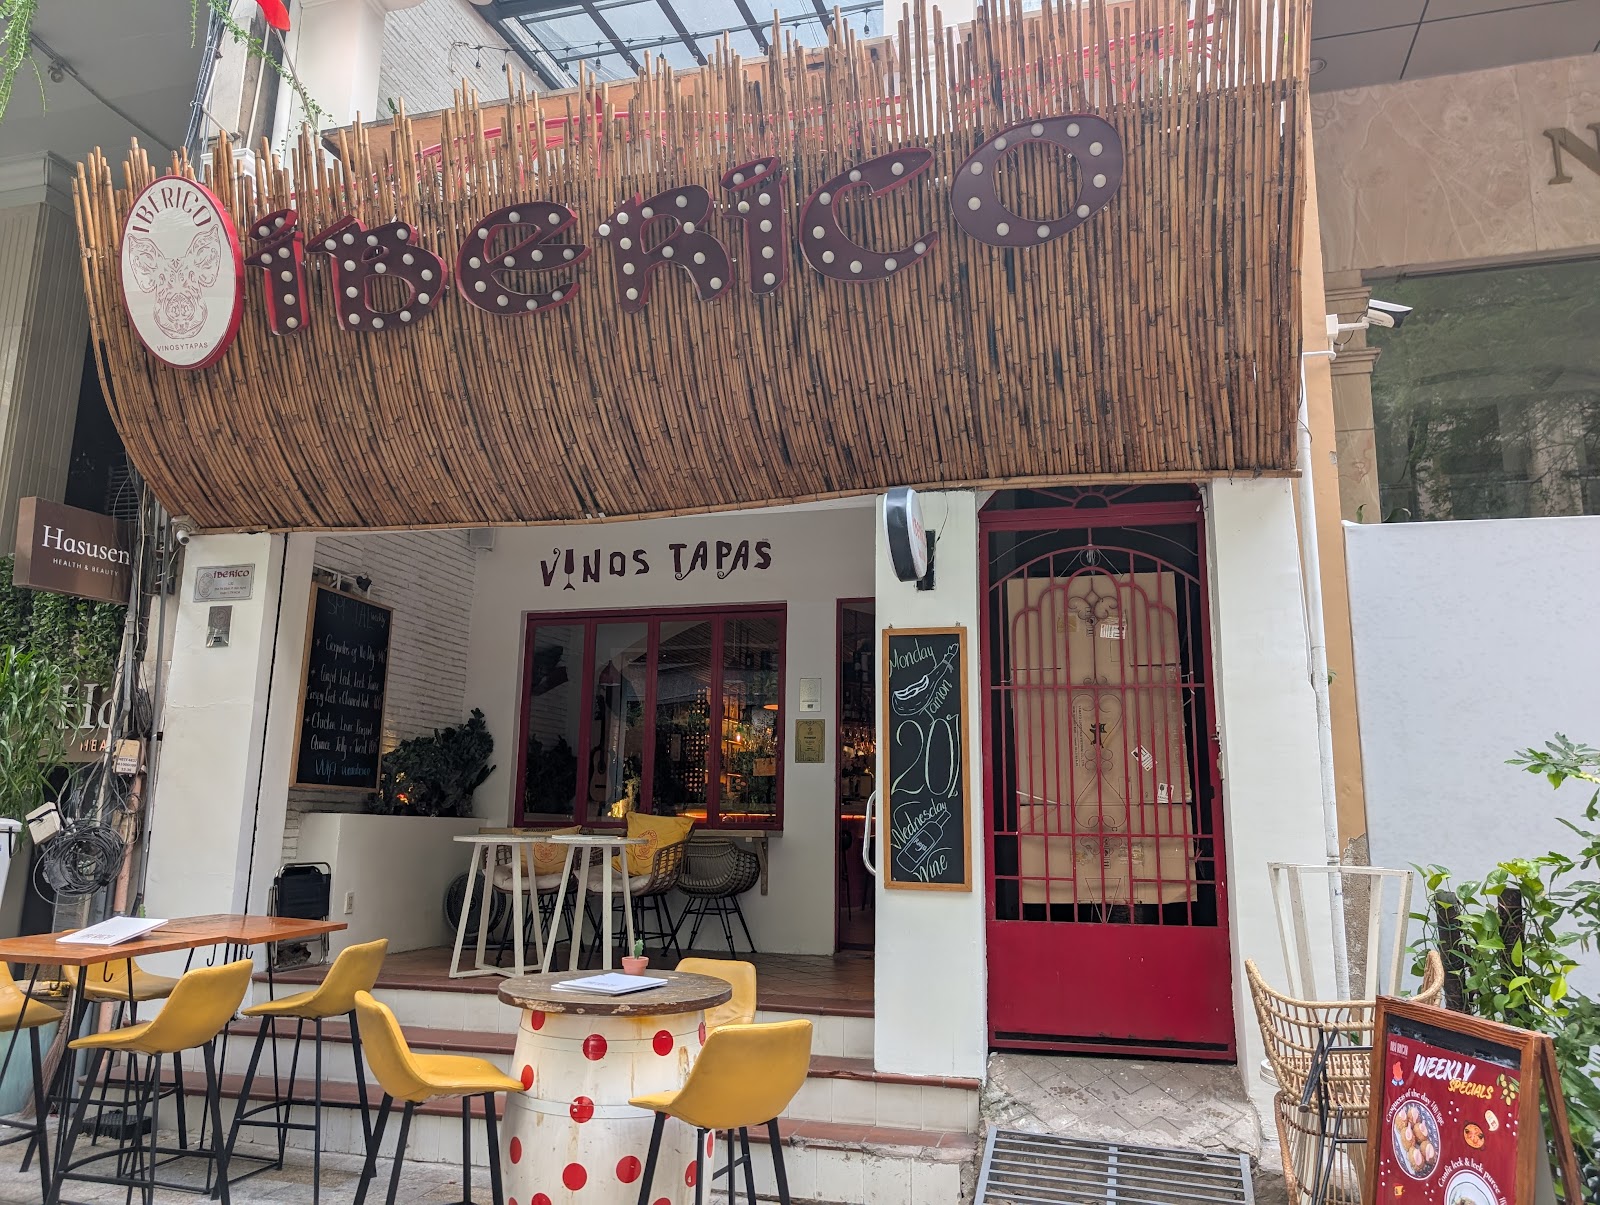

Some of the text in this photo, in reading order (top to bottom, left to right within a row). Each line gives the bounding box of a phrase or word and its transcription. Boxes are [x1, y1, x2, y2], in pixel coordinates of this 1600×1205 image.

[42, 524, 130, 566] Hasusen
[668, 539, 772, 581] TAPAS
[53, 558, 82, 569] HEALTH
[91, 565, 119, 577] BEAUTY
[889, 638, 937, 678] Monday
[891, 798, 948, 850] Wednesday
[913, 847, 953, 882] Wine
[1413, 1053, 1476, 1081] WEEKLY
[1411, 1088, 1420, 1098] the
[1447, 1078, 1495, 1100] SPECIALS
[1437, 1165, 1453, 1187] Confit
[1464, 1157, 1470, 1167] &
